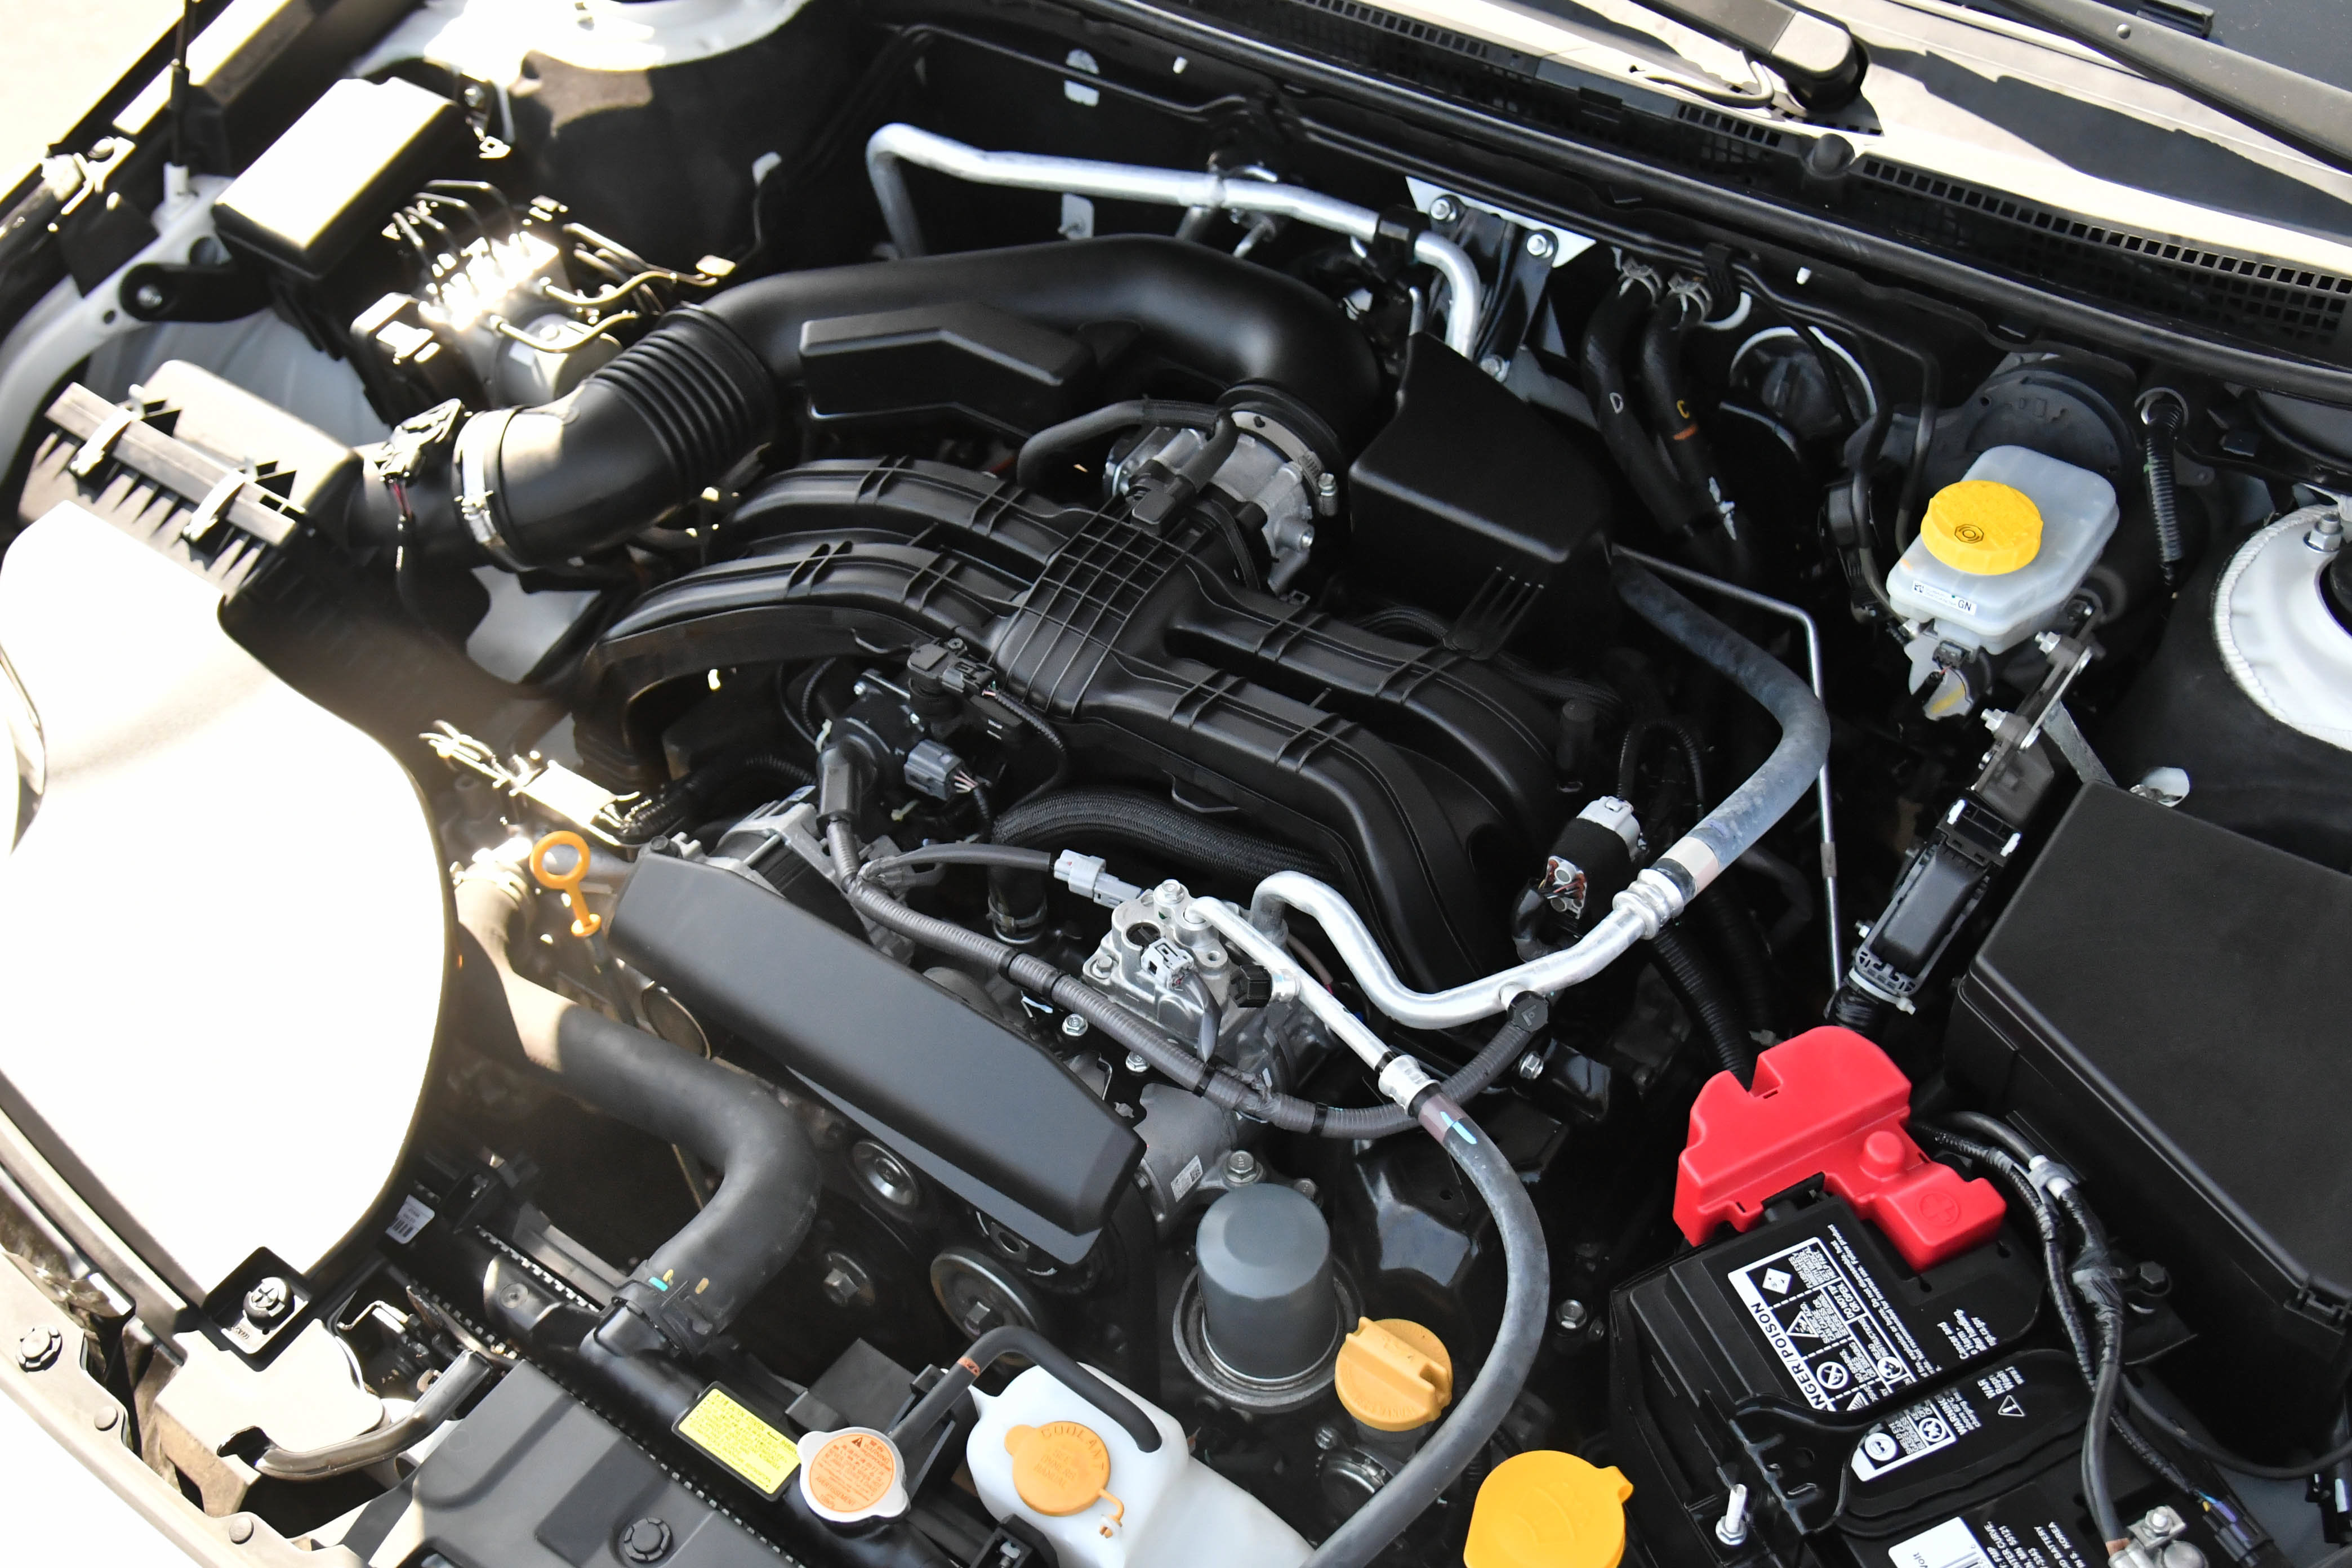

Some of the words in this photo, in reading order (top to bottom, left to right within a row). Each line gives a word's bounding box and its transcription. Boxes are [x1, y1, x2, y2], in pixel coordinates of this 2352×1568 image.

[1609, 393, 1624, 414] D
[1677, 400, 1690, 420] C
[1958, 600, 1972, 611] GN
[1827, 1224, 1847, 1245] product
[1812, 1249, 1826, 1263] FAST.
[1830, 1240, 1842, 1253] heat
[1842, 1245, 1858, 1264] Follow
[1788, 1256, 1802, 1271] EYES
[1804, 1246, 1823, 1270] MEDICAL
[1792, 1253, 1818, 1286] IMMEDIATELY
[1797, 1269, 1814, 1289] FLUSH
[1811, 1269, 1824, 1283] WITH
[1819, 1268, 1830, 1281] GET
[1823, 1264, 1836, 1279] HELP
[1827, 1284, 1838, 1294] TIP
[1837, 1281, 1854, 1302] OPEN.
[1863, 1288, 1874, 1298] not
[1864, 1277, 1884, 1300] inverted
[1812, 1298, 1823, 1308] OR
[1817, 1293, 1834, 1314] BURNS.
[1833, 1294, 1848, 1308] NOT
[1848, 1300, 1860, 1312] OR
[1870, 1298, 1880, 1308] Do
[1880, 1300, 1890, 1309] for
[1811, 1308, 1828, 1328] CAUSE
[1843, 1307, 1855, 1318] DO
[1808, 1317, 1830, 1344] SULFURIC
[1818, 1307, 1842, 1339] BLINDNESS
[1830, 1313, 1848, 1336] SEVERE
[1885, 1308, 1917, 1349] recommended
[1937, 1321, 1953, 1335] and
[1971, 1317, 1997, 1347] ngs.ca.gov
[1824, 1328, 1836, 1340] CAN
[1857, 1317, 1888, 1356] INSTRUCTIONS
[1957, 1330, 1975, 1351] Harm
[1972, 1337, 1987, 1351] after
[1848, 1342, 1870, 1368] SMOKING
[1868, 1343, 1882, 1360] READ
[1895, 1332, 1917, 1360] explosion
[1913, 1348, 1925, 1360] Not
[1948, 1335, 1970, 1360] Cancer
[1750, 1302, 1829, 1413] ANGER/POISON
[1851, 1356, 1870, 1380] FLAMES
[1854, 1373, 1865, 1383] NO
[1865, 1367, 1877, 1378] OR
[1977, 1378, 1997, 1398] WAR
[1958, 1411, 1974, 1431] above
[1959, 1400, 1981, 1428] charging
[1900, 1416, 1925, 1449] BLINDNESS
[1901, 1431, 1919, 1452] GASES
[1041, 1425, 1105, 1471] COOLANT
[1895, 1433, 1913, 1454] SHIELD
[1984, 1521, 2007, 1549] CURVE,
[1998, 1525, 2018, 1546] 55121
[2034, 1526, 2063, 1560] BATTERY
[2048, 1521, 2072, 1549] KOREA
[1986, 1547, 2003, 1562] FMP
[2002, 1548, 2021, 1568] NTER
[2014, 1547, 2028, 1560] MN
[2069, 1551, 2079, 1560] S.
